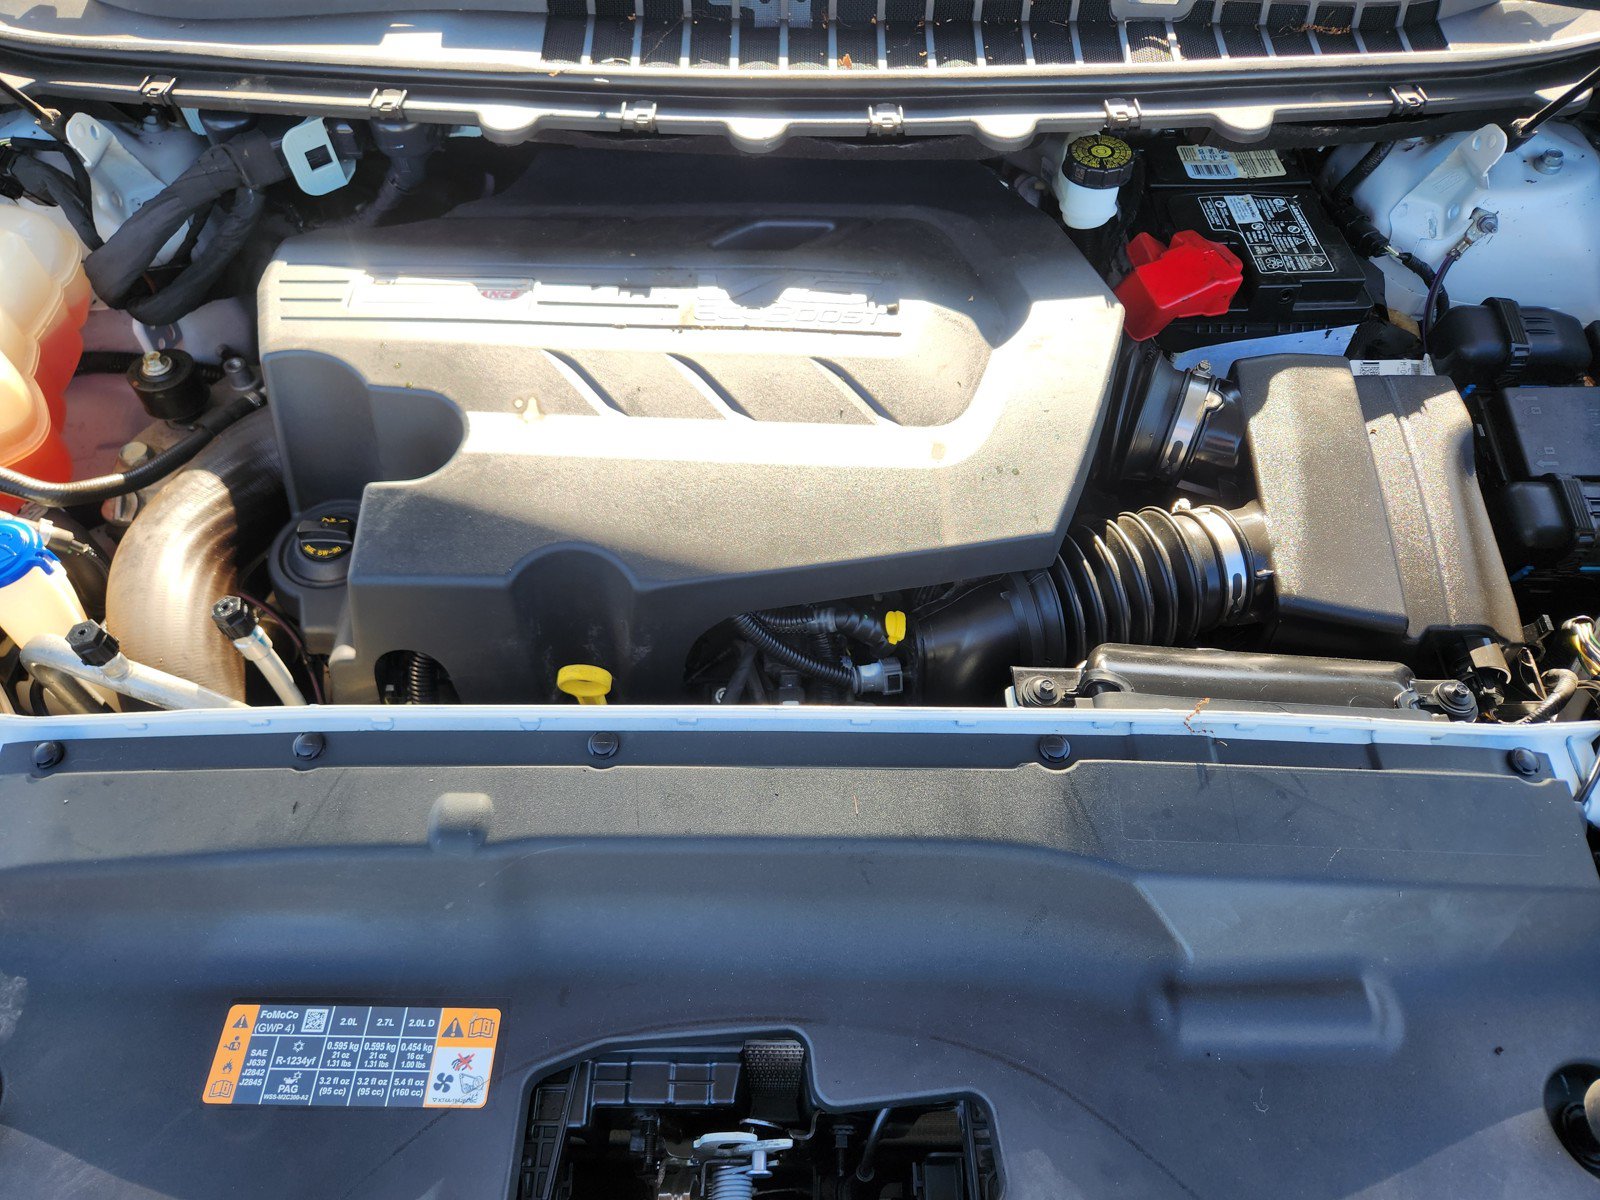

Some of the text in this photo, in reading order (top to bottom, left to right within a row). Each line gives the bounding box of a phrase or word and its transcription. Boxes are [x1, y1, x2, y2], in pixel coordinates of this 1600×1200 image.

[260, 1010, 299, 1020] FoMoCo
[339, 1018, 358, 1026] 2.0L
[376, 1018, 395, 1027] 2.7L
[408, 1018, 435, 1027] 2.0L D
[254, 1023, 296, 1034] (GWP 4)
[327, 1041, 360, 1052] 0.595 kg
[364, 1042, 397, 1053] 0.595 kg
[400, 1043, 434, 1053] 0.454 kg
[250, 1049, 268, 1057] SAE
[246, 1058, 266, 1067] J639
[275, 1056, 317, 1067] R-1234yf
[364, 1060, 389, 1068] 1.31 lbs
[400, 1061, 426, 1069] 1.00 lbs
[242, 1068, 265, 1076] J2842
[239, 1078, 263, 1086] J2845
[332, 1077, 339, 1085] fl
[357, 1078, 370, 1086] 3.2
[394, 1078, 407, 1086] 5.4
[407, 1078, 414, 1086] fl
[277, 1084, 299, 1094] PAG
[319, 1087, 347, 1096] (95 cc)
[357, 1088, 384, 1097] (95 cc)
[392, 1088, 424, 1097] (160 cc)
